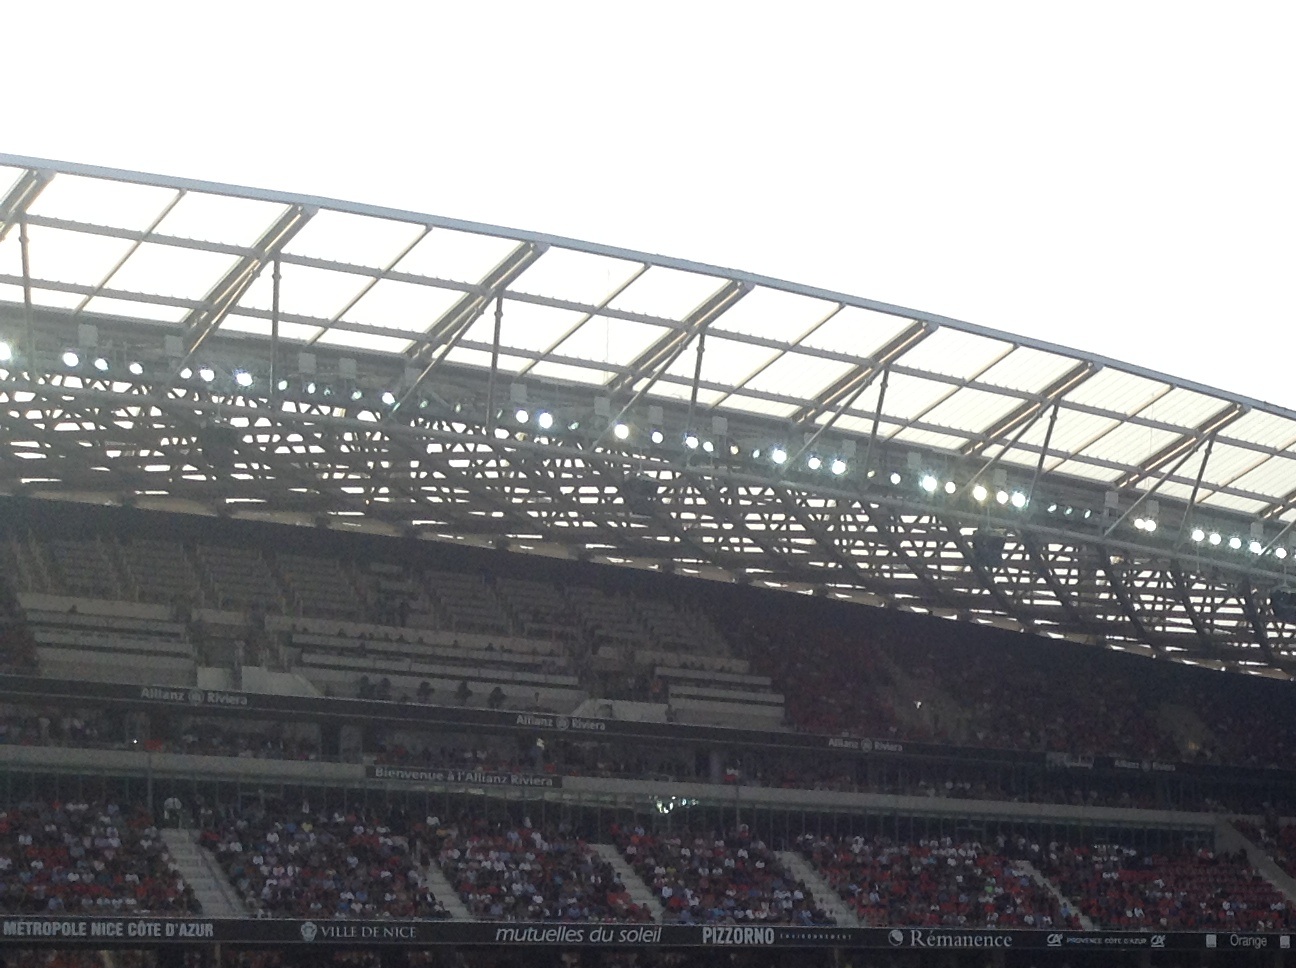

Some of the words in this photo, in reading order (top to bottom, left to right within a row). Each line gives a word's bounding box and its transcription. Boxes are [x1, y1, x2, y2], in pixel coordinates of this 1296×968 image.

[140, 687, 185, 701] Allianz
[207, 691, 248, 706] Riviera
[516, 714, 553, 727] Allianz
[571, 717, 606, 731] Riviera
[375, 767, 443, 782] Bienvenue
[446, 769, 456, 781] à
[457, 771, 508, 784] l'Allianz
[510, 775, 553, 787] Riviera
[3, 919, 87, 936] MÉTROPOLE
[91, 922, 123, 937] NICE
[127, 920, 162, 937] CÔTE
[166, 922, 214, 938] D'AZUR
[321, 926, 357, 938] VILLE
[361, 927, 379, 938] DE
[384, 927, 416, 939] NICE
[495, 926, 584, 943] mutuelles
[589, 926, 614, 943] du
[618, 926, 662, 944] soleil
[702, 927, 775, 945] PIZZORNO
[910, 929, 1013, 948] Rémanence
[1230, 933, 1267, 949] Orange
